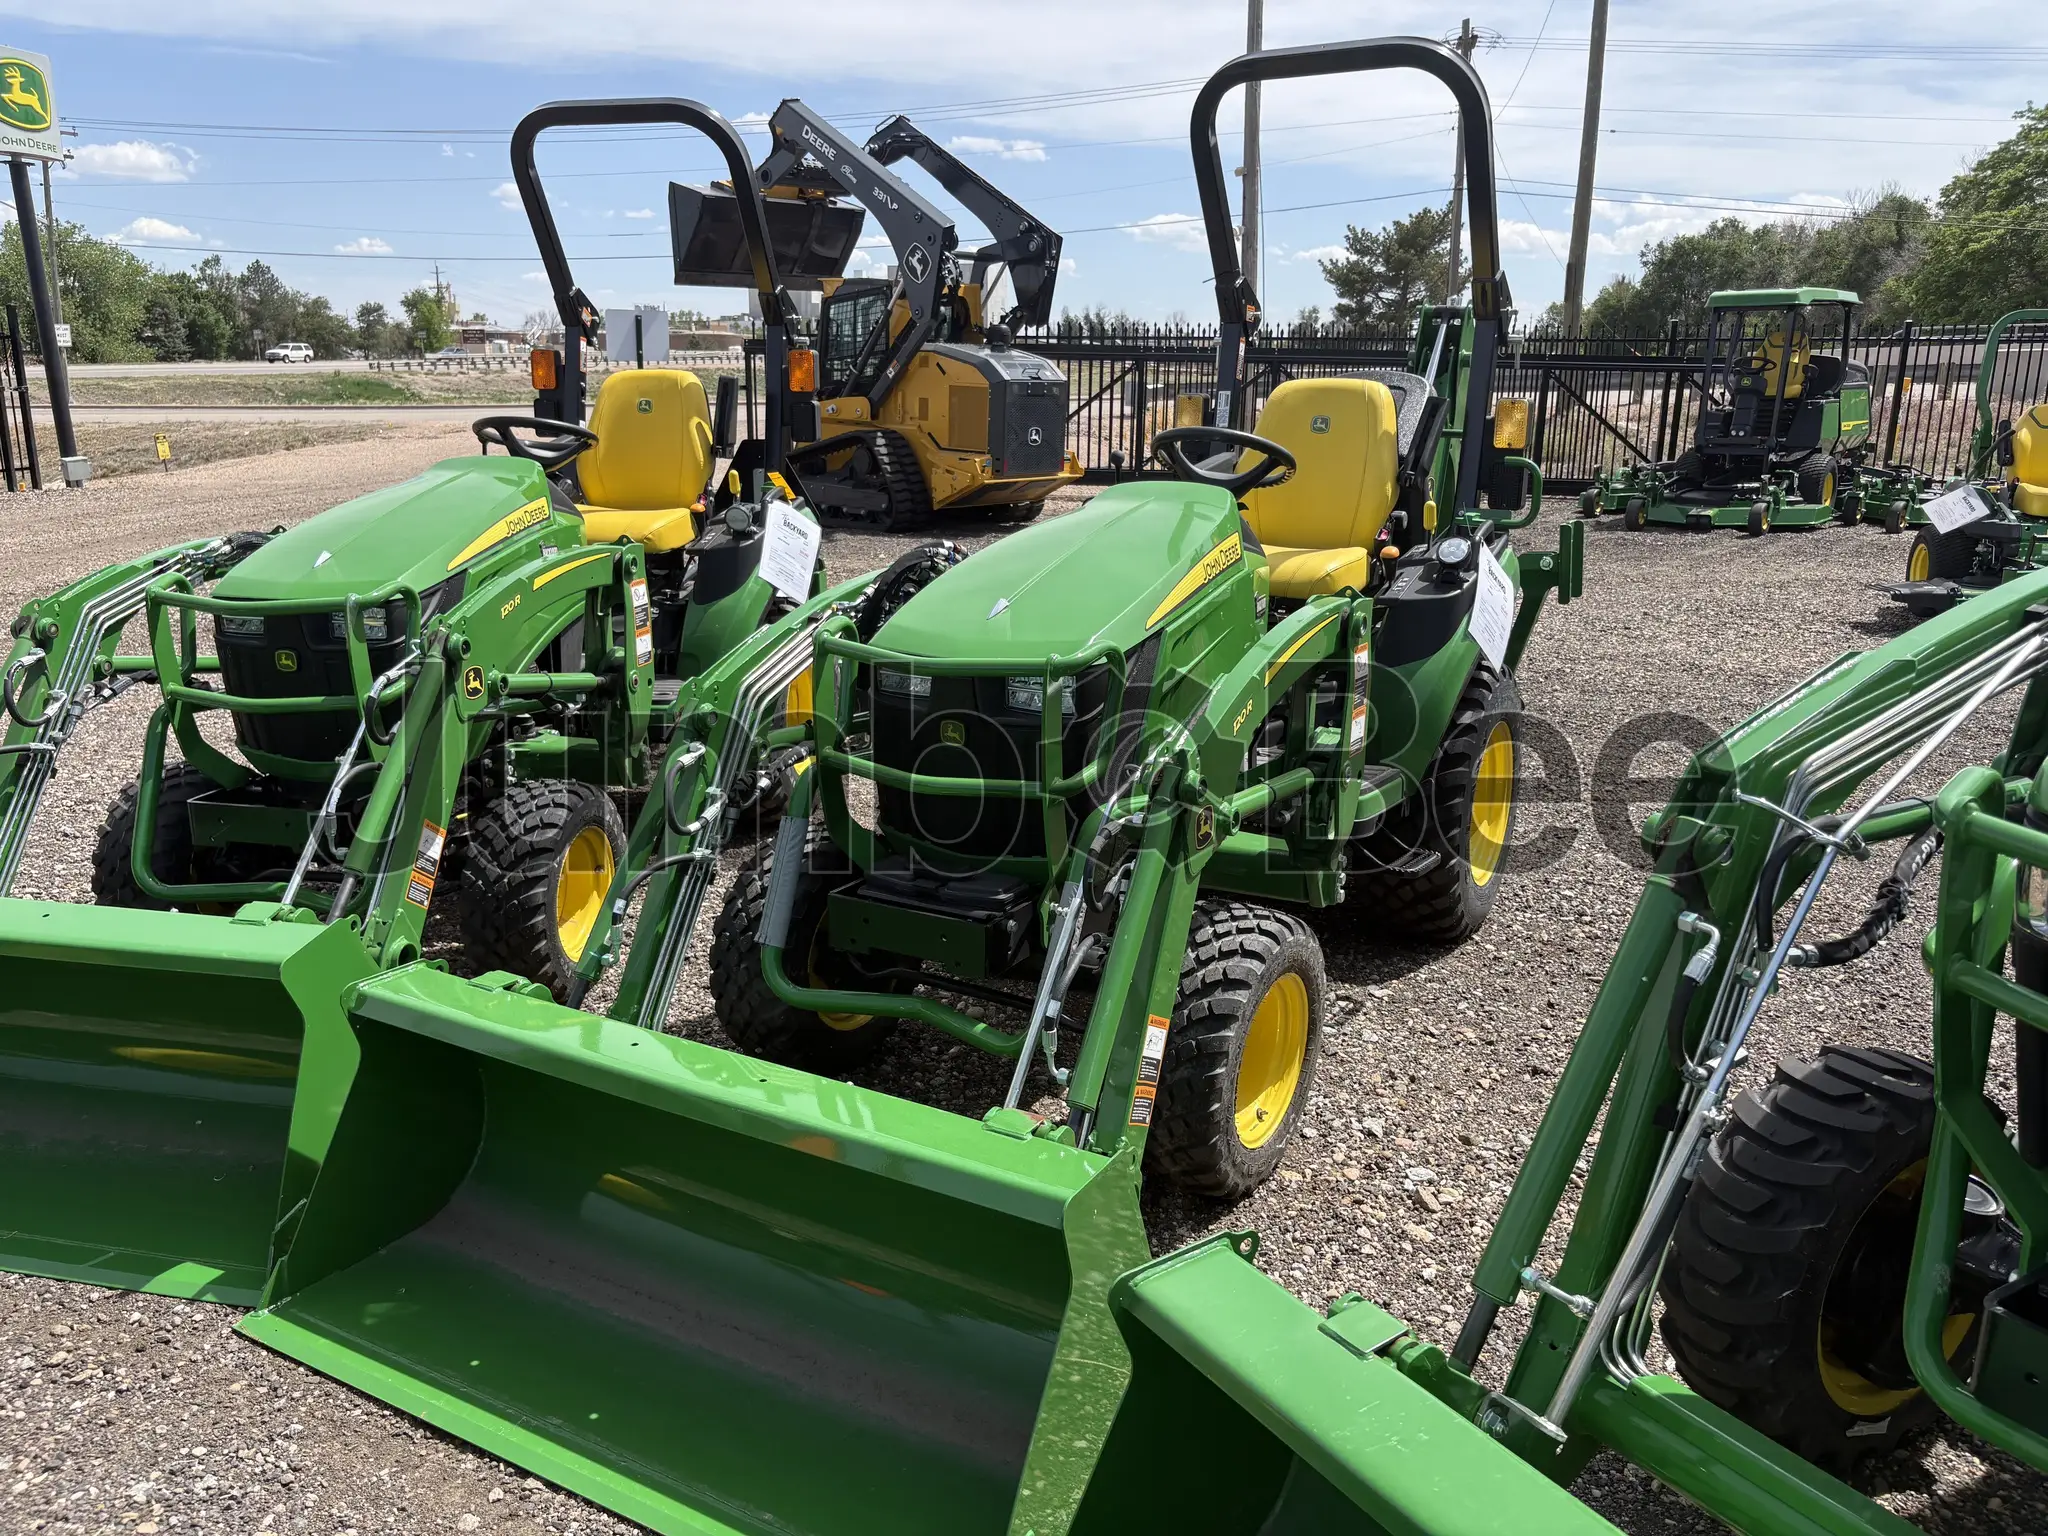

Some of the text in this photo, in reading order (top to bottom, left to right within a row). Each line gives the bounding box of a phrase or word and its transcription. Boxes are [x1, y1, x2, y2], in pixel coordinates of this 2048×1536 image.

[0, 136, 58, 153] OHN DEERE
[801, 125, 838, 162] DEERE
[505, 505, 548, 536] JOHN DEERE
[783, 519, 809, 540] BACKYARD
[1202, 542, 1241, 582] JOHN DEERE
